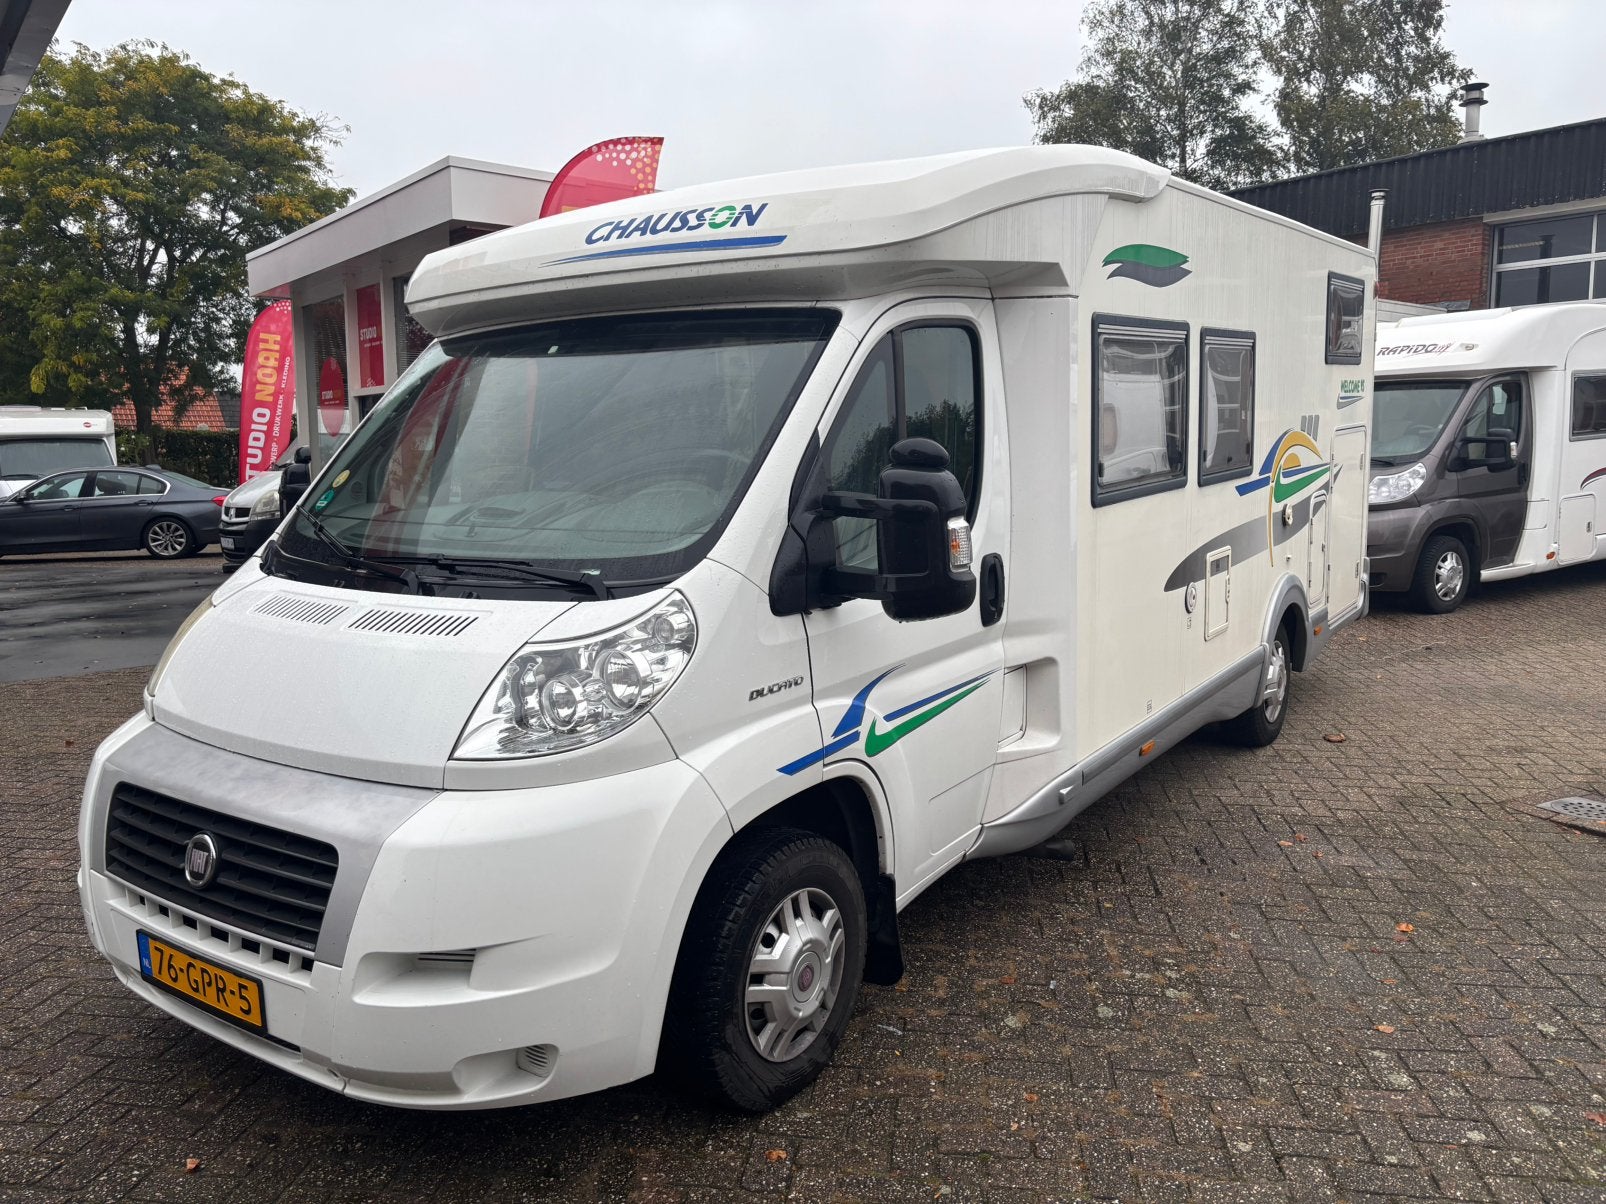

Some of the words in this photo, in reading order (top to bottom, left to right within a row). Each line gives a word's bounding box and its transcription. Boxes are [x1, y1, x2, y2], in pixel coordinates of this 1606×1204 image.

[585, 202, 769, 245] CHAUSSON
[255, 332, 281, 402] NOAH
[272, 394, 284, 437] DRUKWERK
[280, 356, 291, 388] KLEDING
[245, 407, 271, 480] TUDIO
[749, 676, 804, 701] DUCATO
[142, 958, 152, 969] NL
[153, 945, 252, 1016] 76-GPR-5
